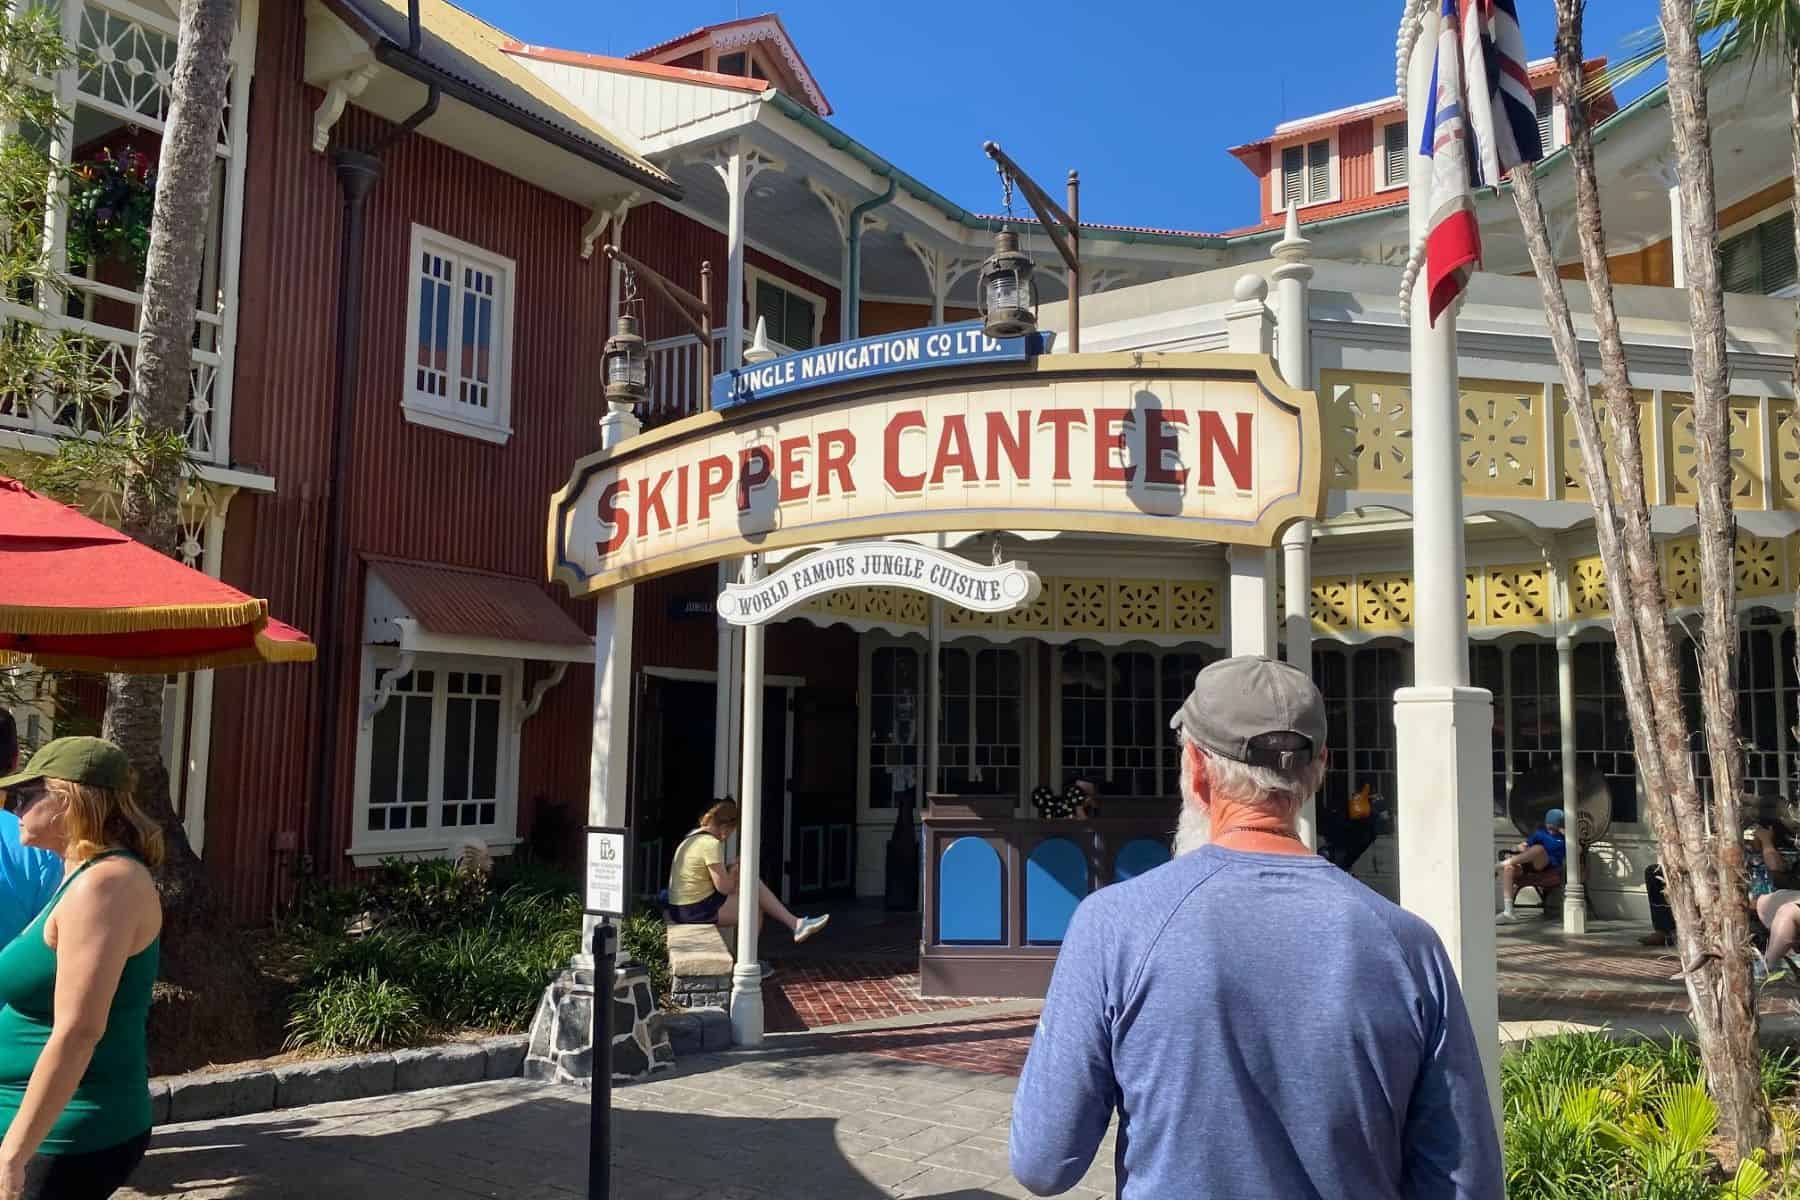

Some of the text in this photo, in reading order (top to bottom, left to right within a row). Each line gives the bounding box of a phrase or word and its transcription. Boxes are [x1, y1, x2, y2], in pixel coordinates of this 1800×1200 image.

[727, 360, 795, 397] JUNGLE
[801, 339, 920, 378] NAVIGATION
[596, 408, 1254, 556] SKIPPER CANTEEN
[739, 553, 1001, 616] WORLD FAMOUS JUNGLE CUISINE
